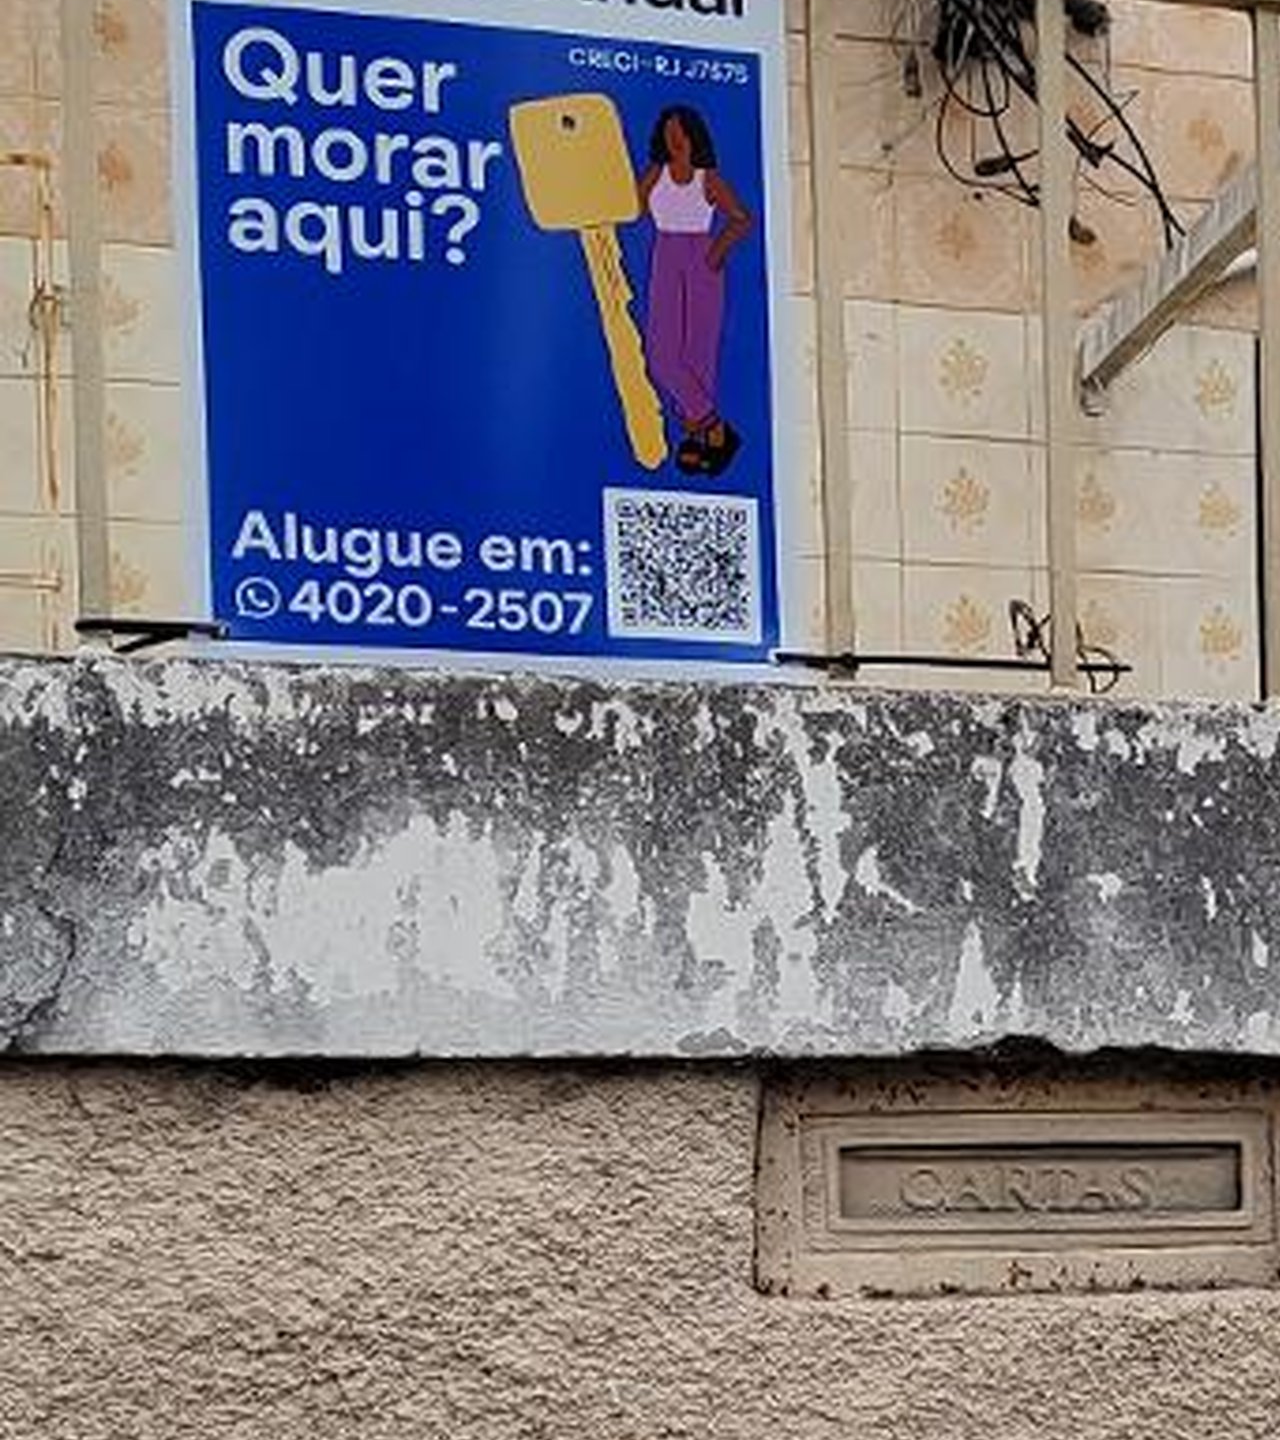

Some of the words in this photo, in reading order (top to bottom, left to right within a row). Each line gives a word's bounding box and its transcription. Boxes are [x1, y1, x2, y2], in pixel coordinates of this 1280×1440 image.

[223, 26, 456, 113] Quer
[227, 121, 503, 192] morar
[228, 190, 481, 274] aqui?
[231, 509, 463, 578] Alugue
[479, 532, 594, 576] em:
[288, 579, 594, 635] 4020-2507
[898, 1166, 1157, 1213] CARTAS
